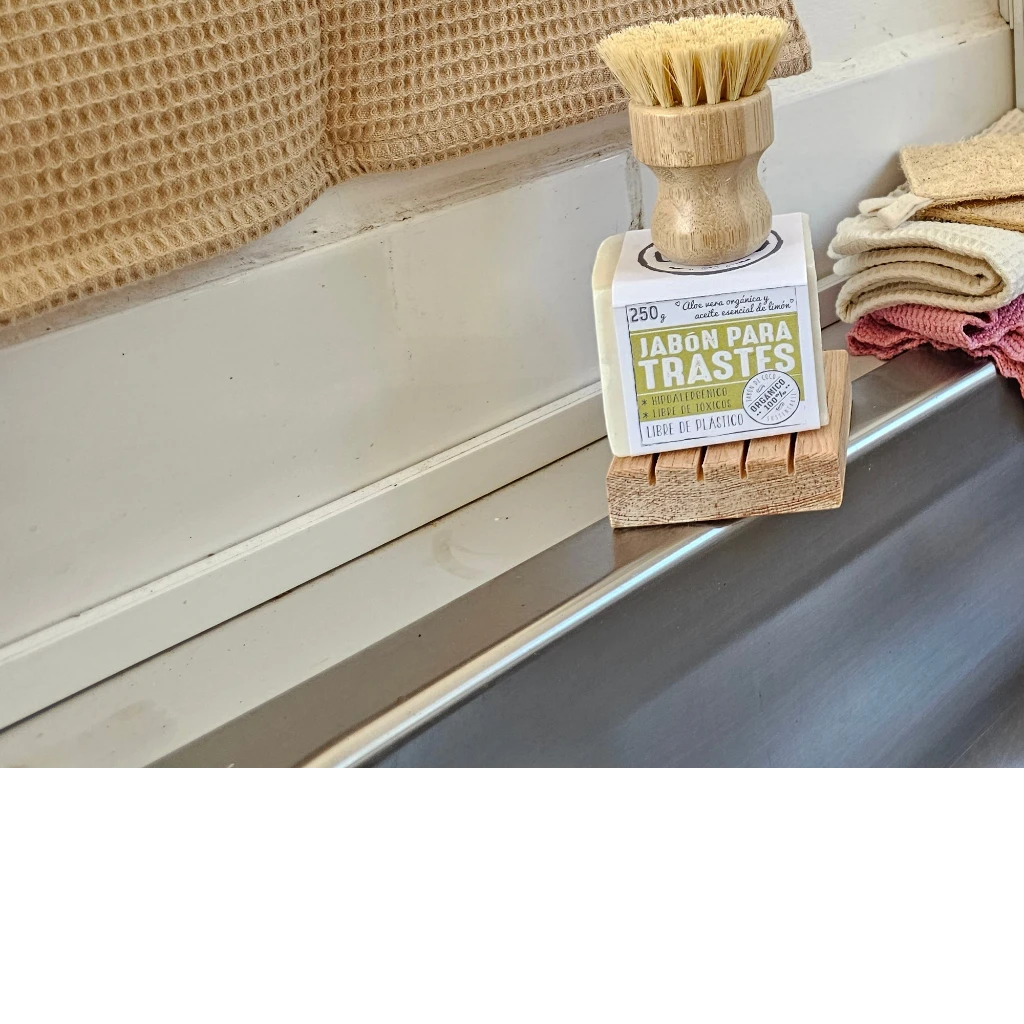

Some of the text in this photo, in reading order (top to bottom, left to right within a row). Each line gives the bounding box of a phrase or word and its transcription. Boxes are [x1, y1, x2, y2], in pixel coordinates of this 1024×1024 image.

[682, 295, 769, 311] Aloe vera orgánica y
[694, 309, 720, 319] aceite
[721, 305, 754, 316] esencial
[756, 303, 766, 312] de
[640, 321, 792, 358] JABÓN PARA
[638, 343, 796, 390] TRASTES
[764, 390, 787, 410] 100%
[681, 404, 691, 415] DE
[646, 422, 674, 438] LIBRE
[679, 420, 691, 434] DE
